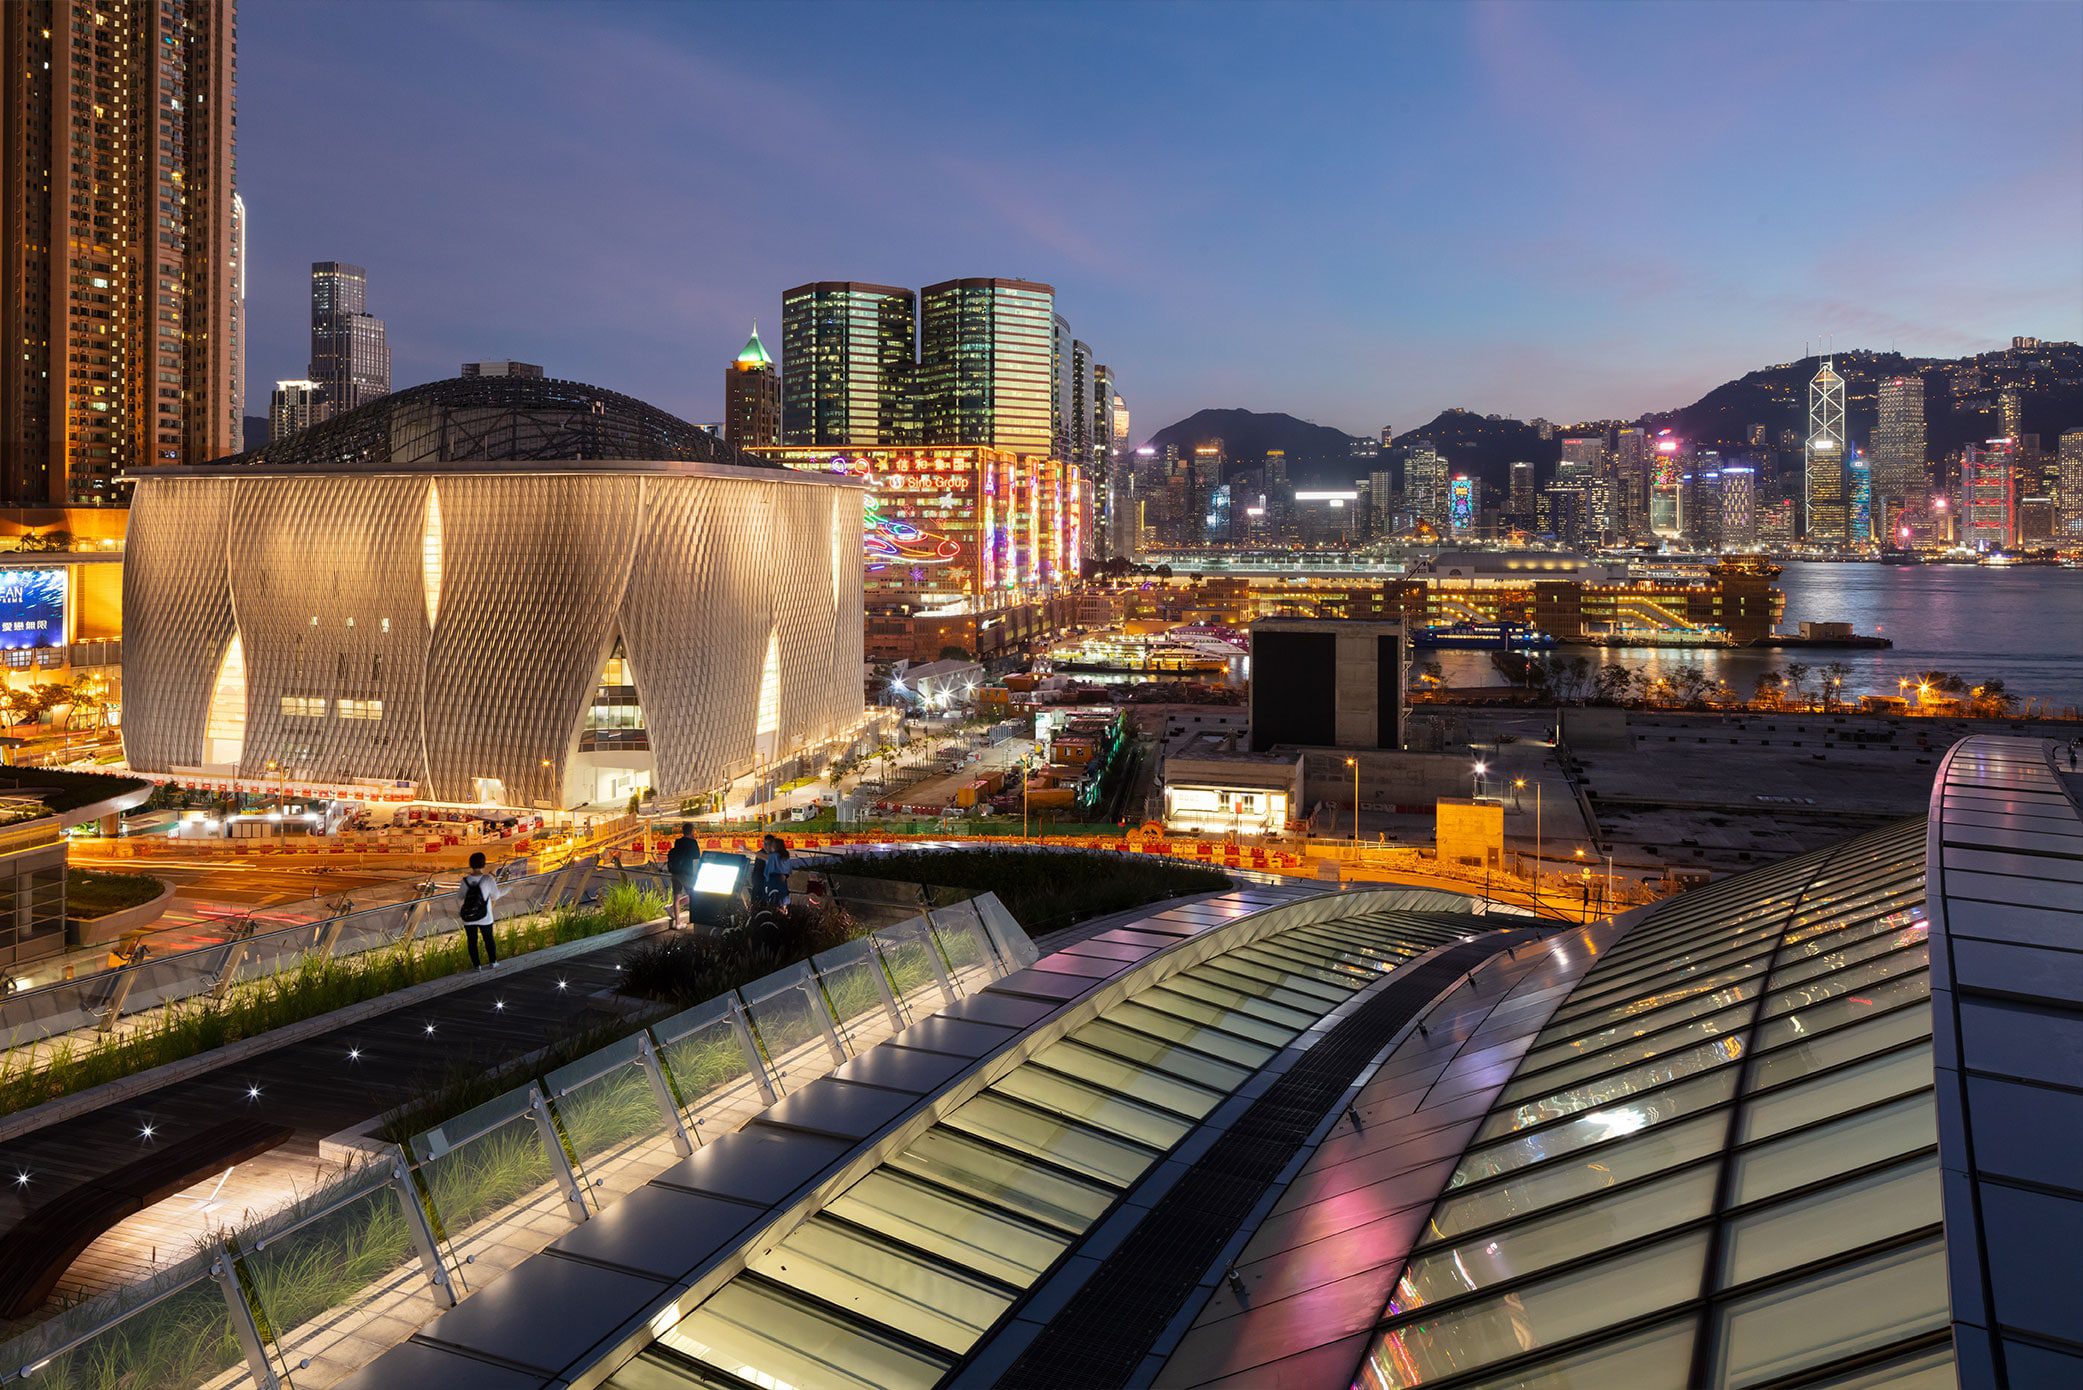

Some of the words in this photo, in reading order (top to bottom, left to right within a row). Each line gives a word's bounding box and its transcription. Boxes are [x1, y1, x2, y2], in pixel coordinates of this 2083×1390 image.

[896, 458, 964, 471] 信和集團
[907, 476, 932, 488] Sino
[935, 476, 969, 490] Group
